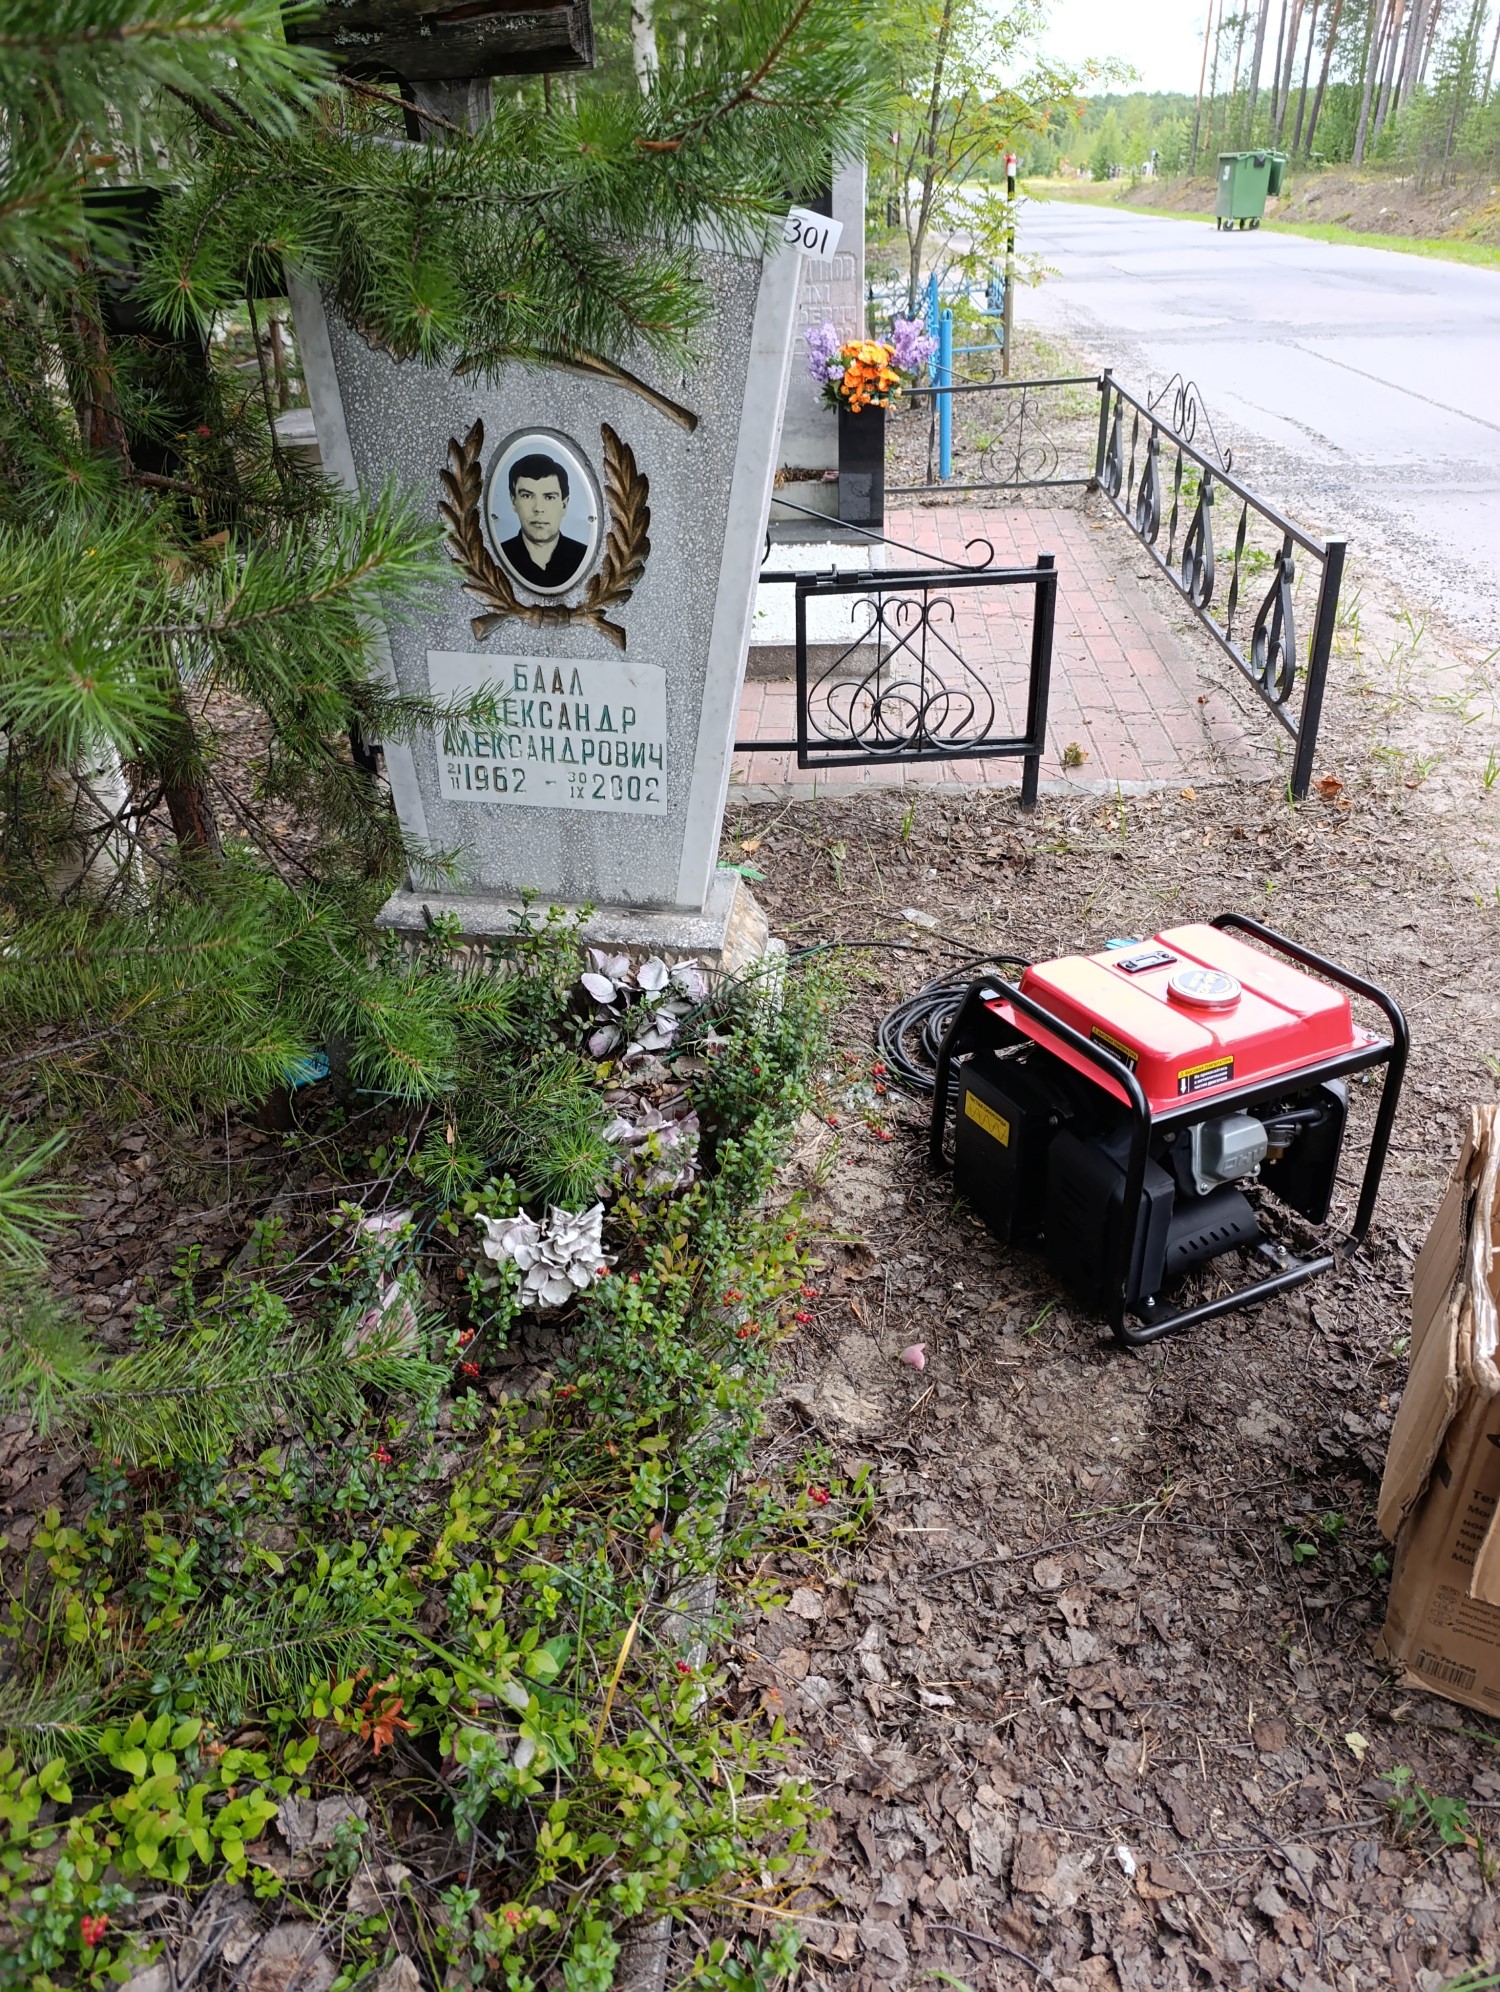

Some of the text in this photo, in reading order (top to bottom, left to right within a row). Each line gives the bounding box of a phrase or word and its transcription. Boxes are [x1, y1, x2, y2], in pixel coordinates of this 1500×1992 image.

[784, 218, 829, 255] 301
[513, 663, 584, 697] БААЛ
[443, 729, 664, 771] АЛЕКСАНДРОВИЧ
[464, 763, 527, 794] 1962
[567, 771, 588, 784] 30
[591, 773, 661, 803] 2002
